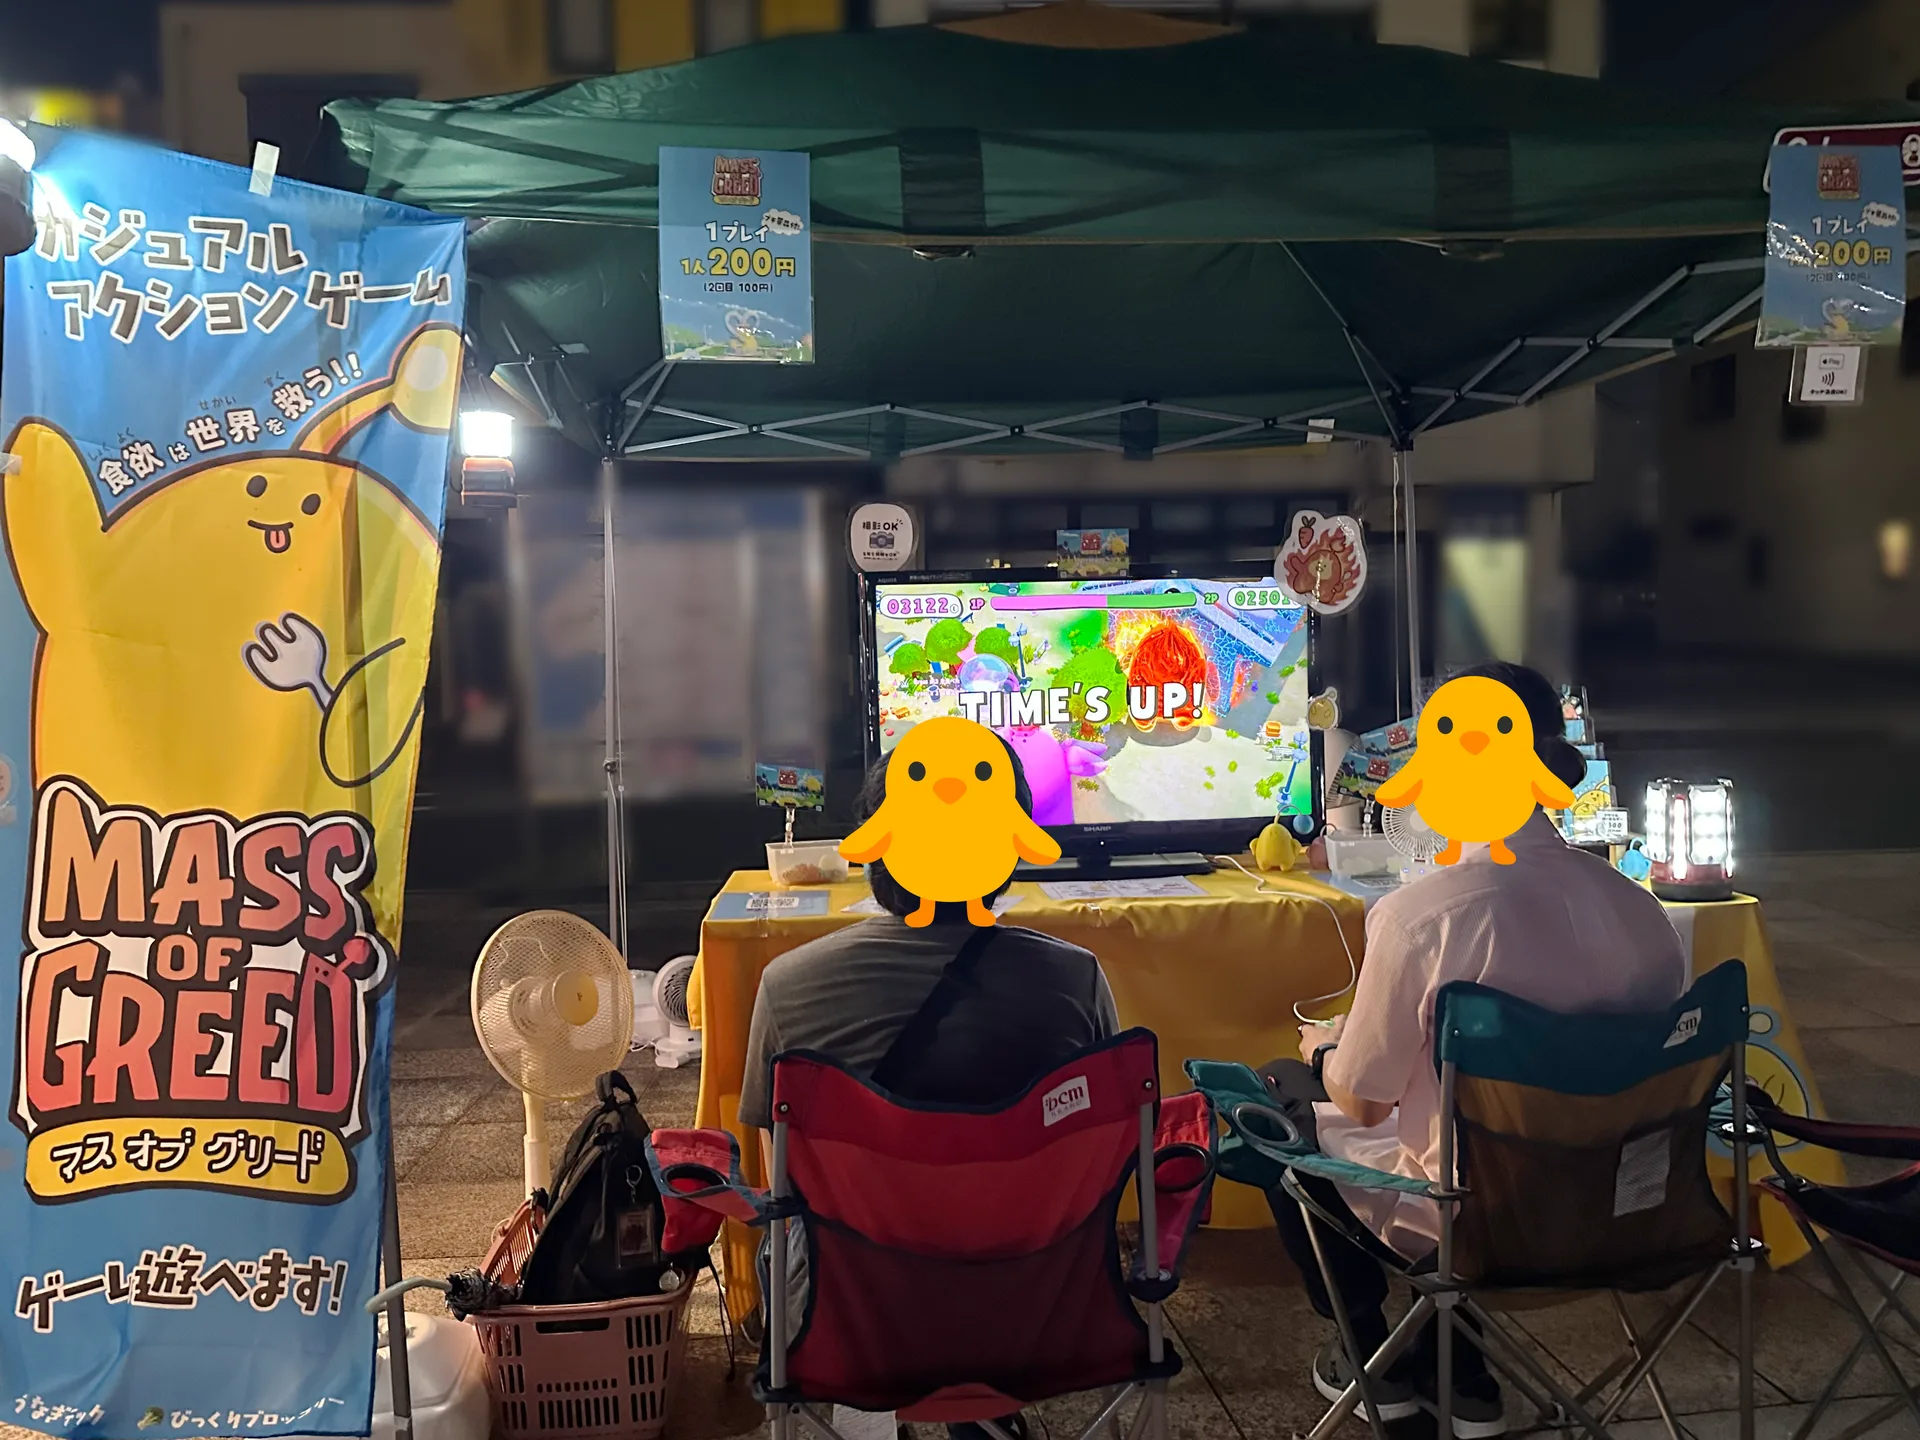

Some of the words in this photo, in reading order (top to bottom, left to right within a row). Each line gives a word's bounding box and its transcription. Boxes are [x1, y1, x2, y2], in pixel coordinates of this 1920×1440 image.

[715, 155, 758, 174] MASS
[36, 201, 308, 274] カジュアル
[705, 220, 769, 243] 1プレイ
[1811, 214, 1869, 235] 1プレイ
[680, 246, 796, 277] 1人200円
[47, 266, 452, 343] アクションゲーム
[887, 597, 949, 615] 03122
[969, 597, 985, 610] 1P
[1204, 592, 1219, 605] 2P
[958, 681, 1111, 728] TIME'S
[1128, 681, 1206, 721] UP!
[1083, 825, 1112, 833] SHARP
[42, 787, 358, 943] MASS
[155, 933, 243, 982] OF
[26, 938, 357, 1114] GREED
[51, 1131, 117, 1184] マス
[125, 1127, 195, 1172] オブ
[204, 1129, 326, 1182] グリード
